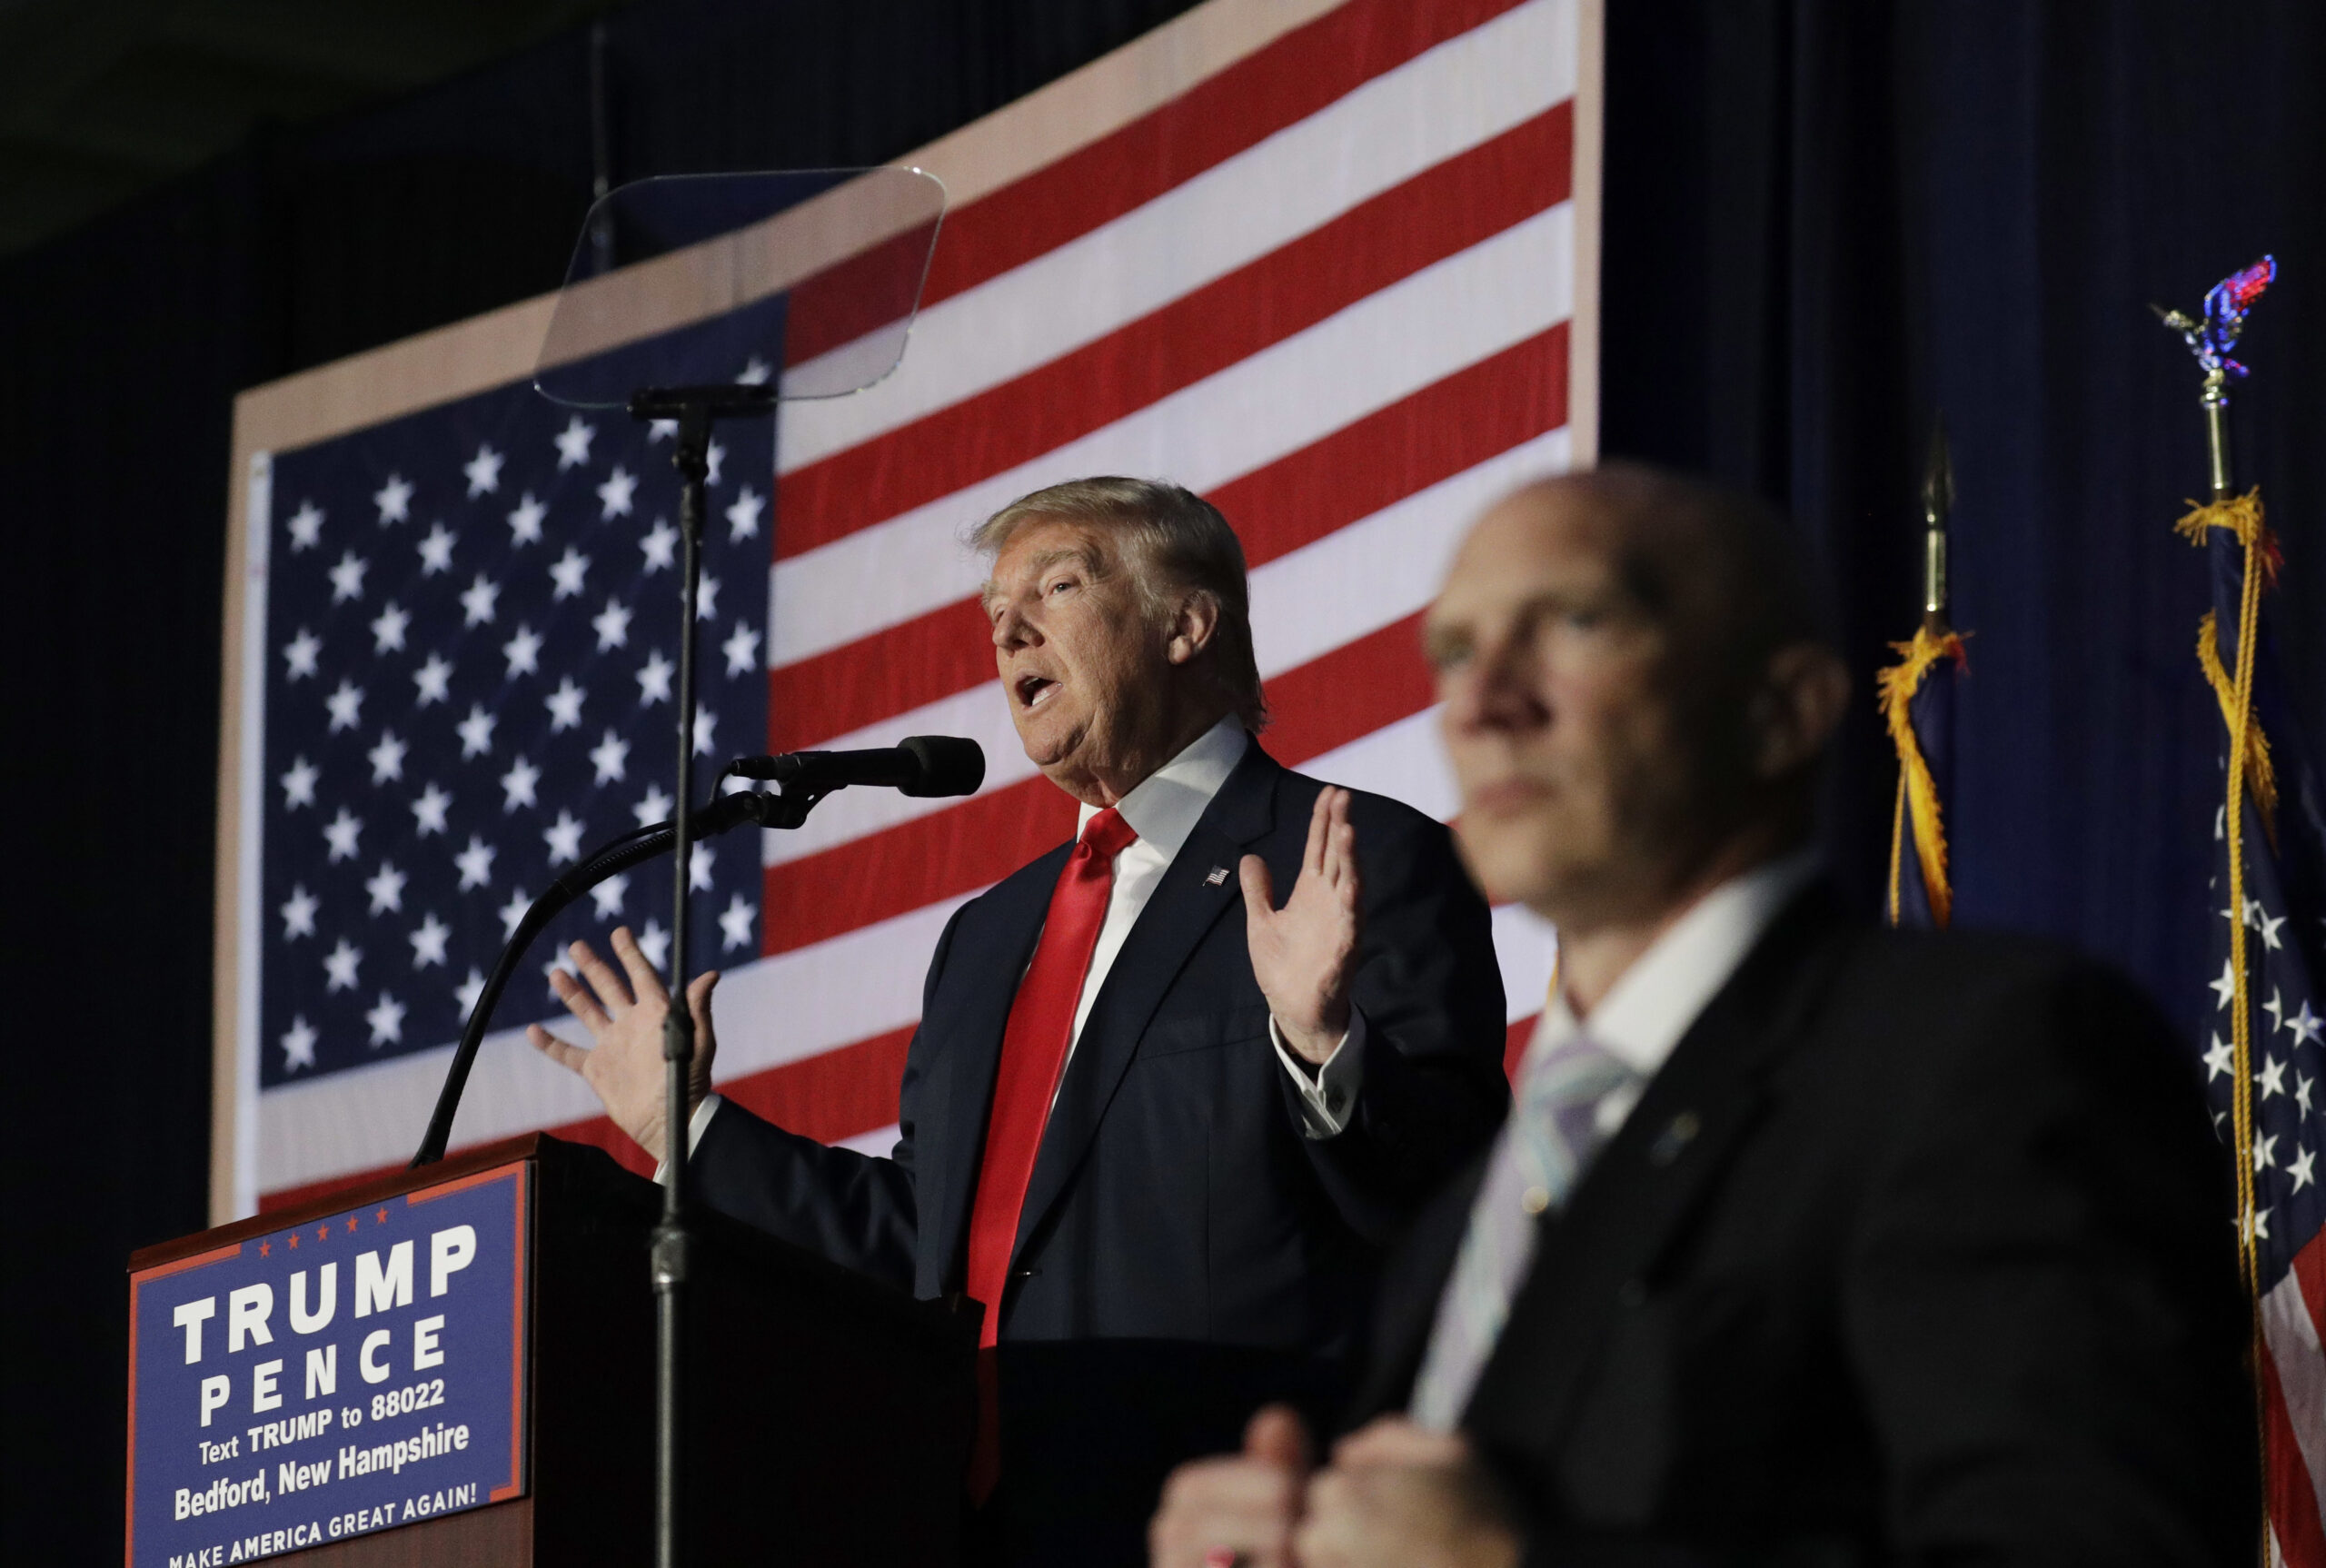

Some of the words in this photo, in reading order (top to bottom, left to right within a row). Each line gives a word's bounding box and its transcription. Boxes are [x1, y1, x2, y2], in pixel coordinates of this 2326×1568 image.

[173, 1224, 477, 1365] TRUMP
[200, 1314, 445, 1428] PENCE
[198, 1435, 240, 1465] Text
[246, 1408, 333, 1454] TRUMP
[341, 1406, 363, 1429] to
[371, 1378, 445, 1422] 88022
[174, 1468, 271, 1521] Bedford,
[278, 1459, 333, 1495] New
[338, 1422, 470, 1481] Hampshire
[169, 1544, 224, 1568] MAKE
[229, 1521, 323, 1563] AMERICA
[328, 1502, 396, 1538] GREAT
[402, 1482, 477, 1521] AGAIN!
